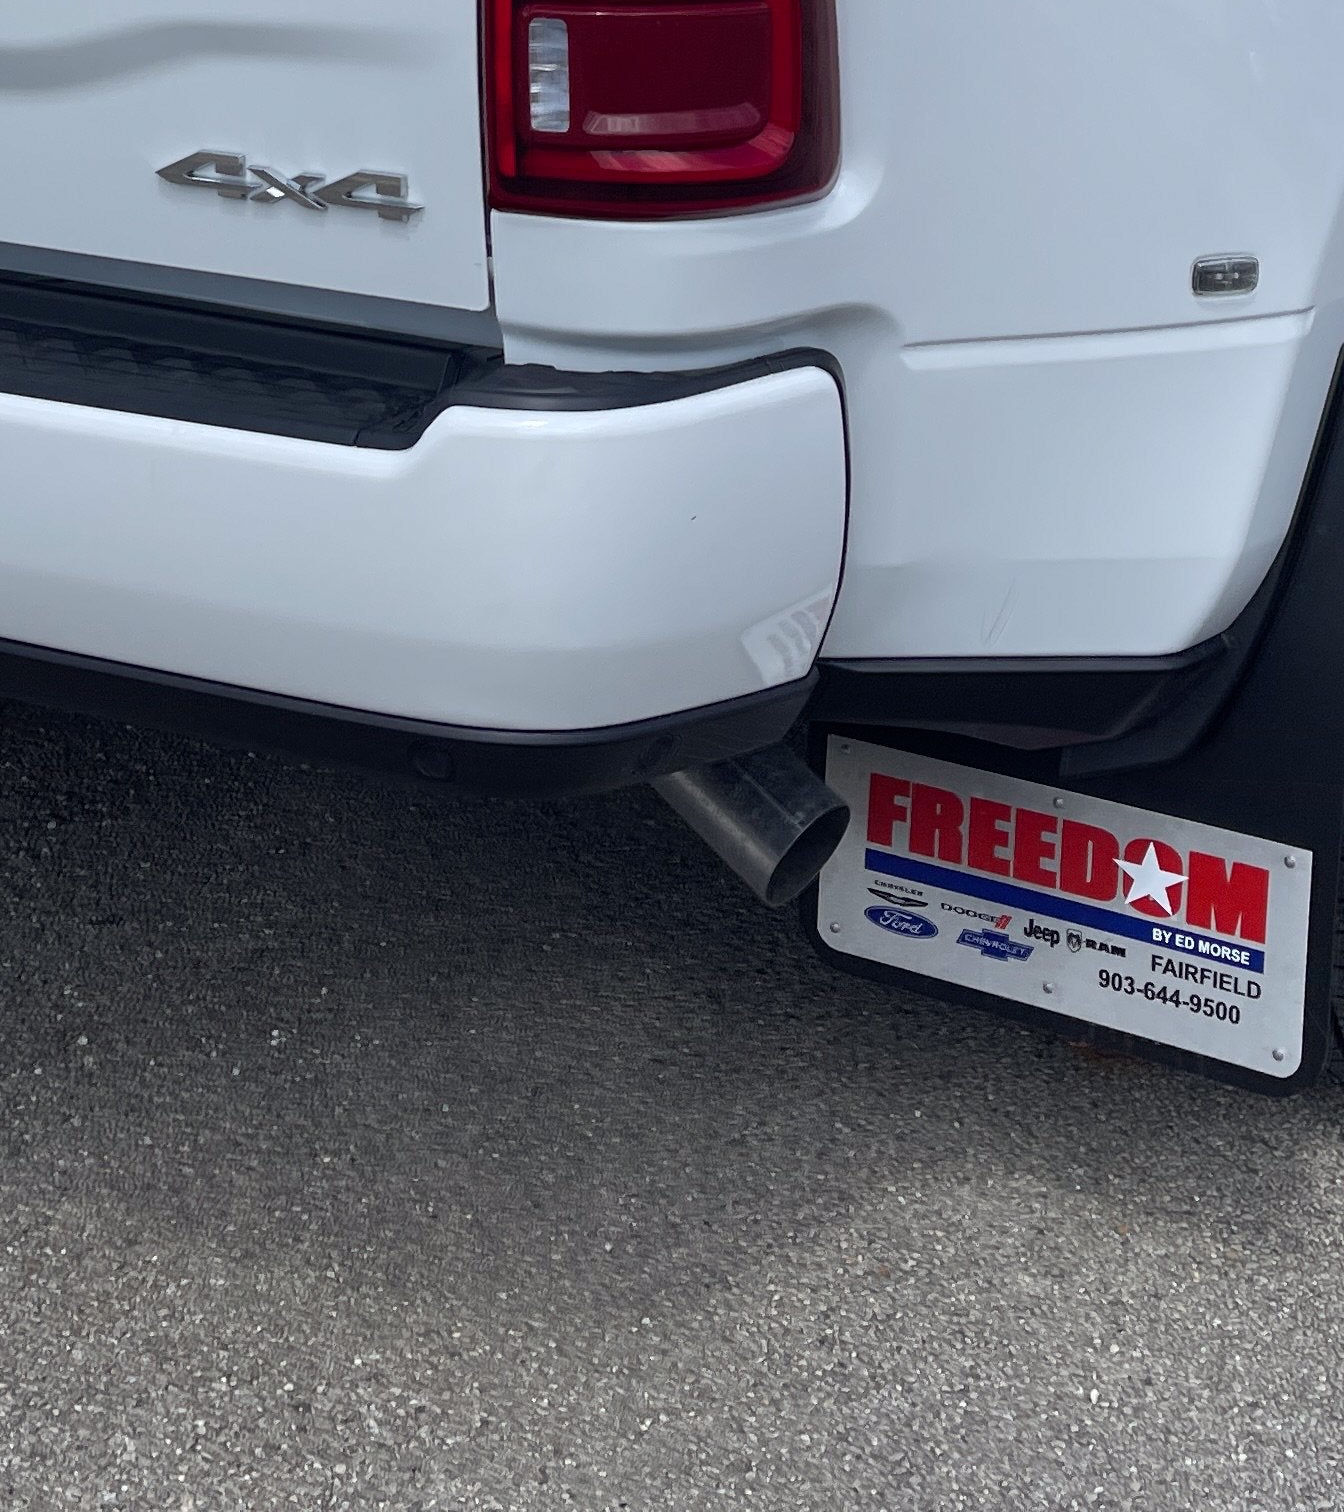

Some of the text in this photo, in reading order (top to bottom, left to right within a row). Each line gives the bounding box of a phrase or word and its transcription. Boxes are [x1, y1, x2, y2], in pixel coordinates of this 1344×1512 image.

[866, 772, 1270, 945] FREEDOM
[879, 910, 923, 934] Ford
[1023, 919, 1060, 948] Jeep
[1085, 938, 1126, 958] RAM
[1151, 927, 1251, 966] BY ED MORSE
[1098, 968, 1241, 1025] 903-644-9500
[1151, 954, 1262, 1000] FAIRFIELD
